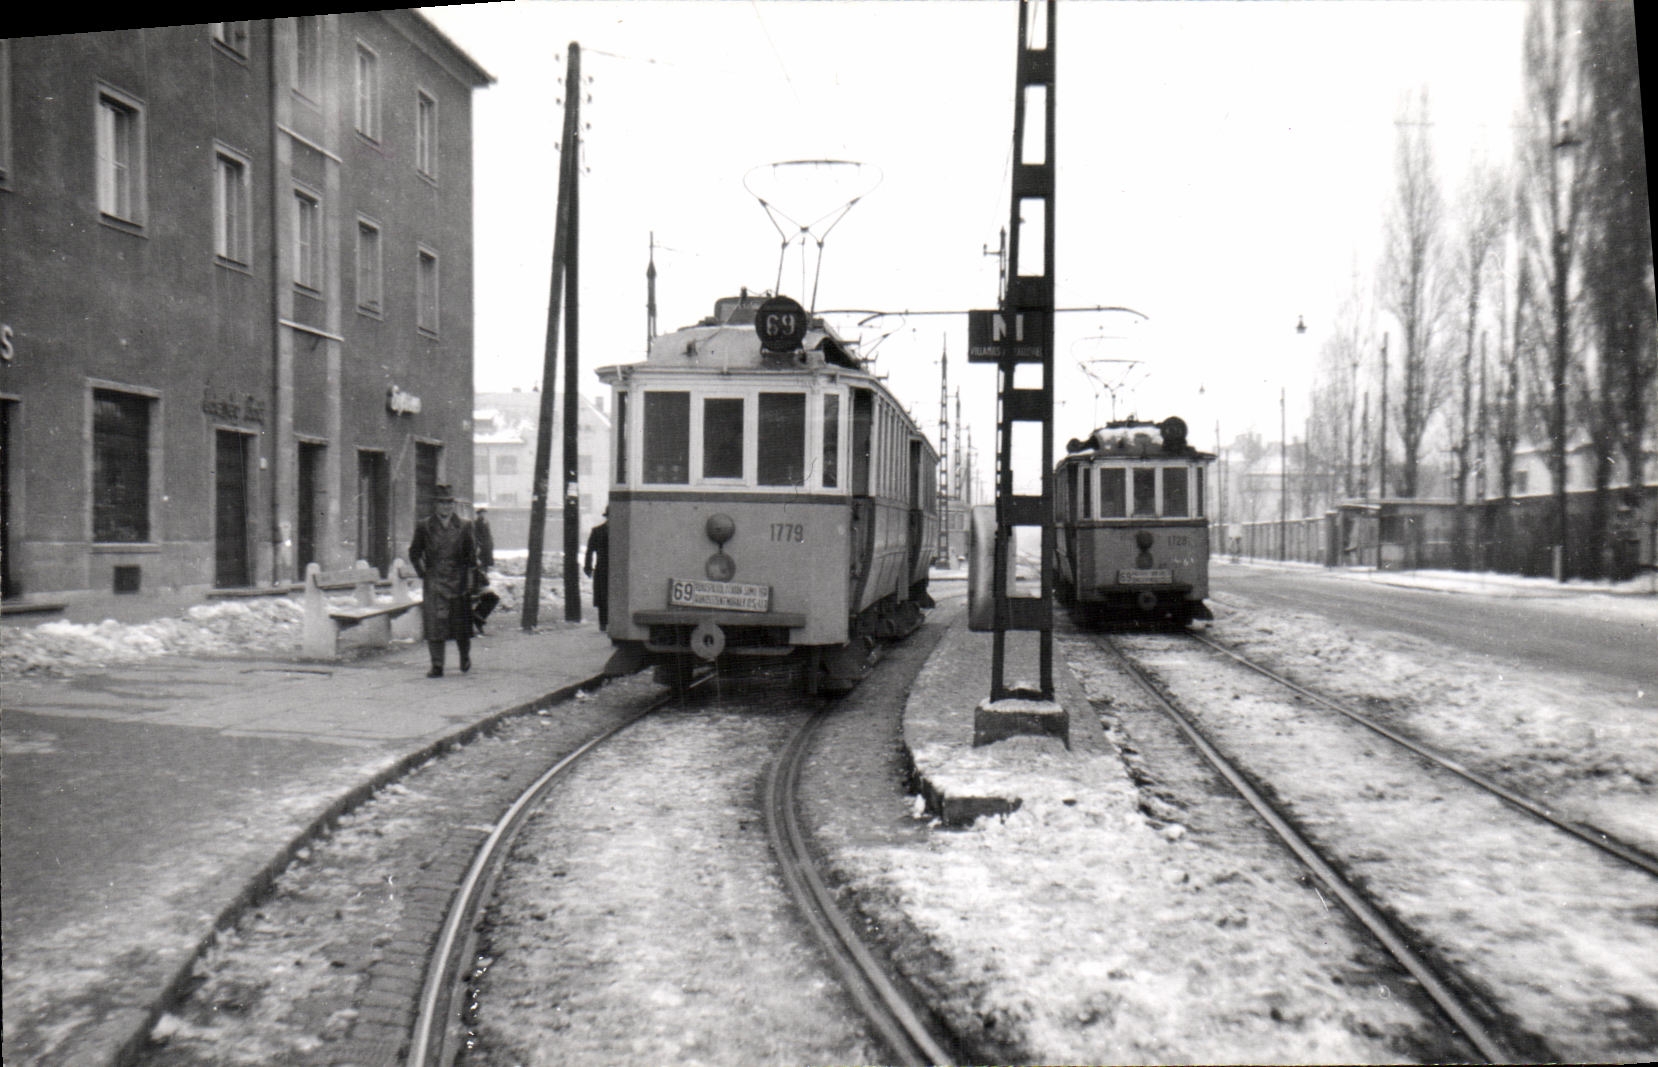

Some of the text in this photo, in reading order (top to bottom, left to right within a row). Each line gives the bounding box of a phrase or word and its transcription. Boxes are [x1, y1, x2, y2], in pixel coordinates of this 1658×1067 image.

[765, 313, 796, 337] 69
[770, 523, 804, 542] 1779
[674, 582, 693, 601] 69
